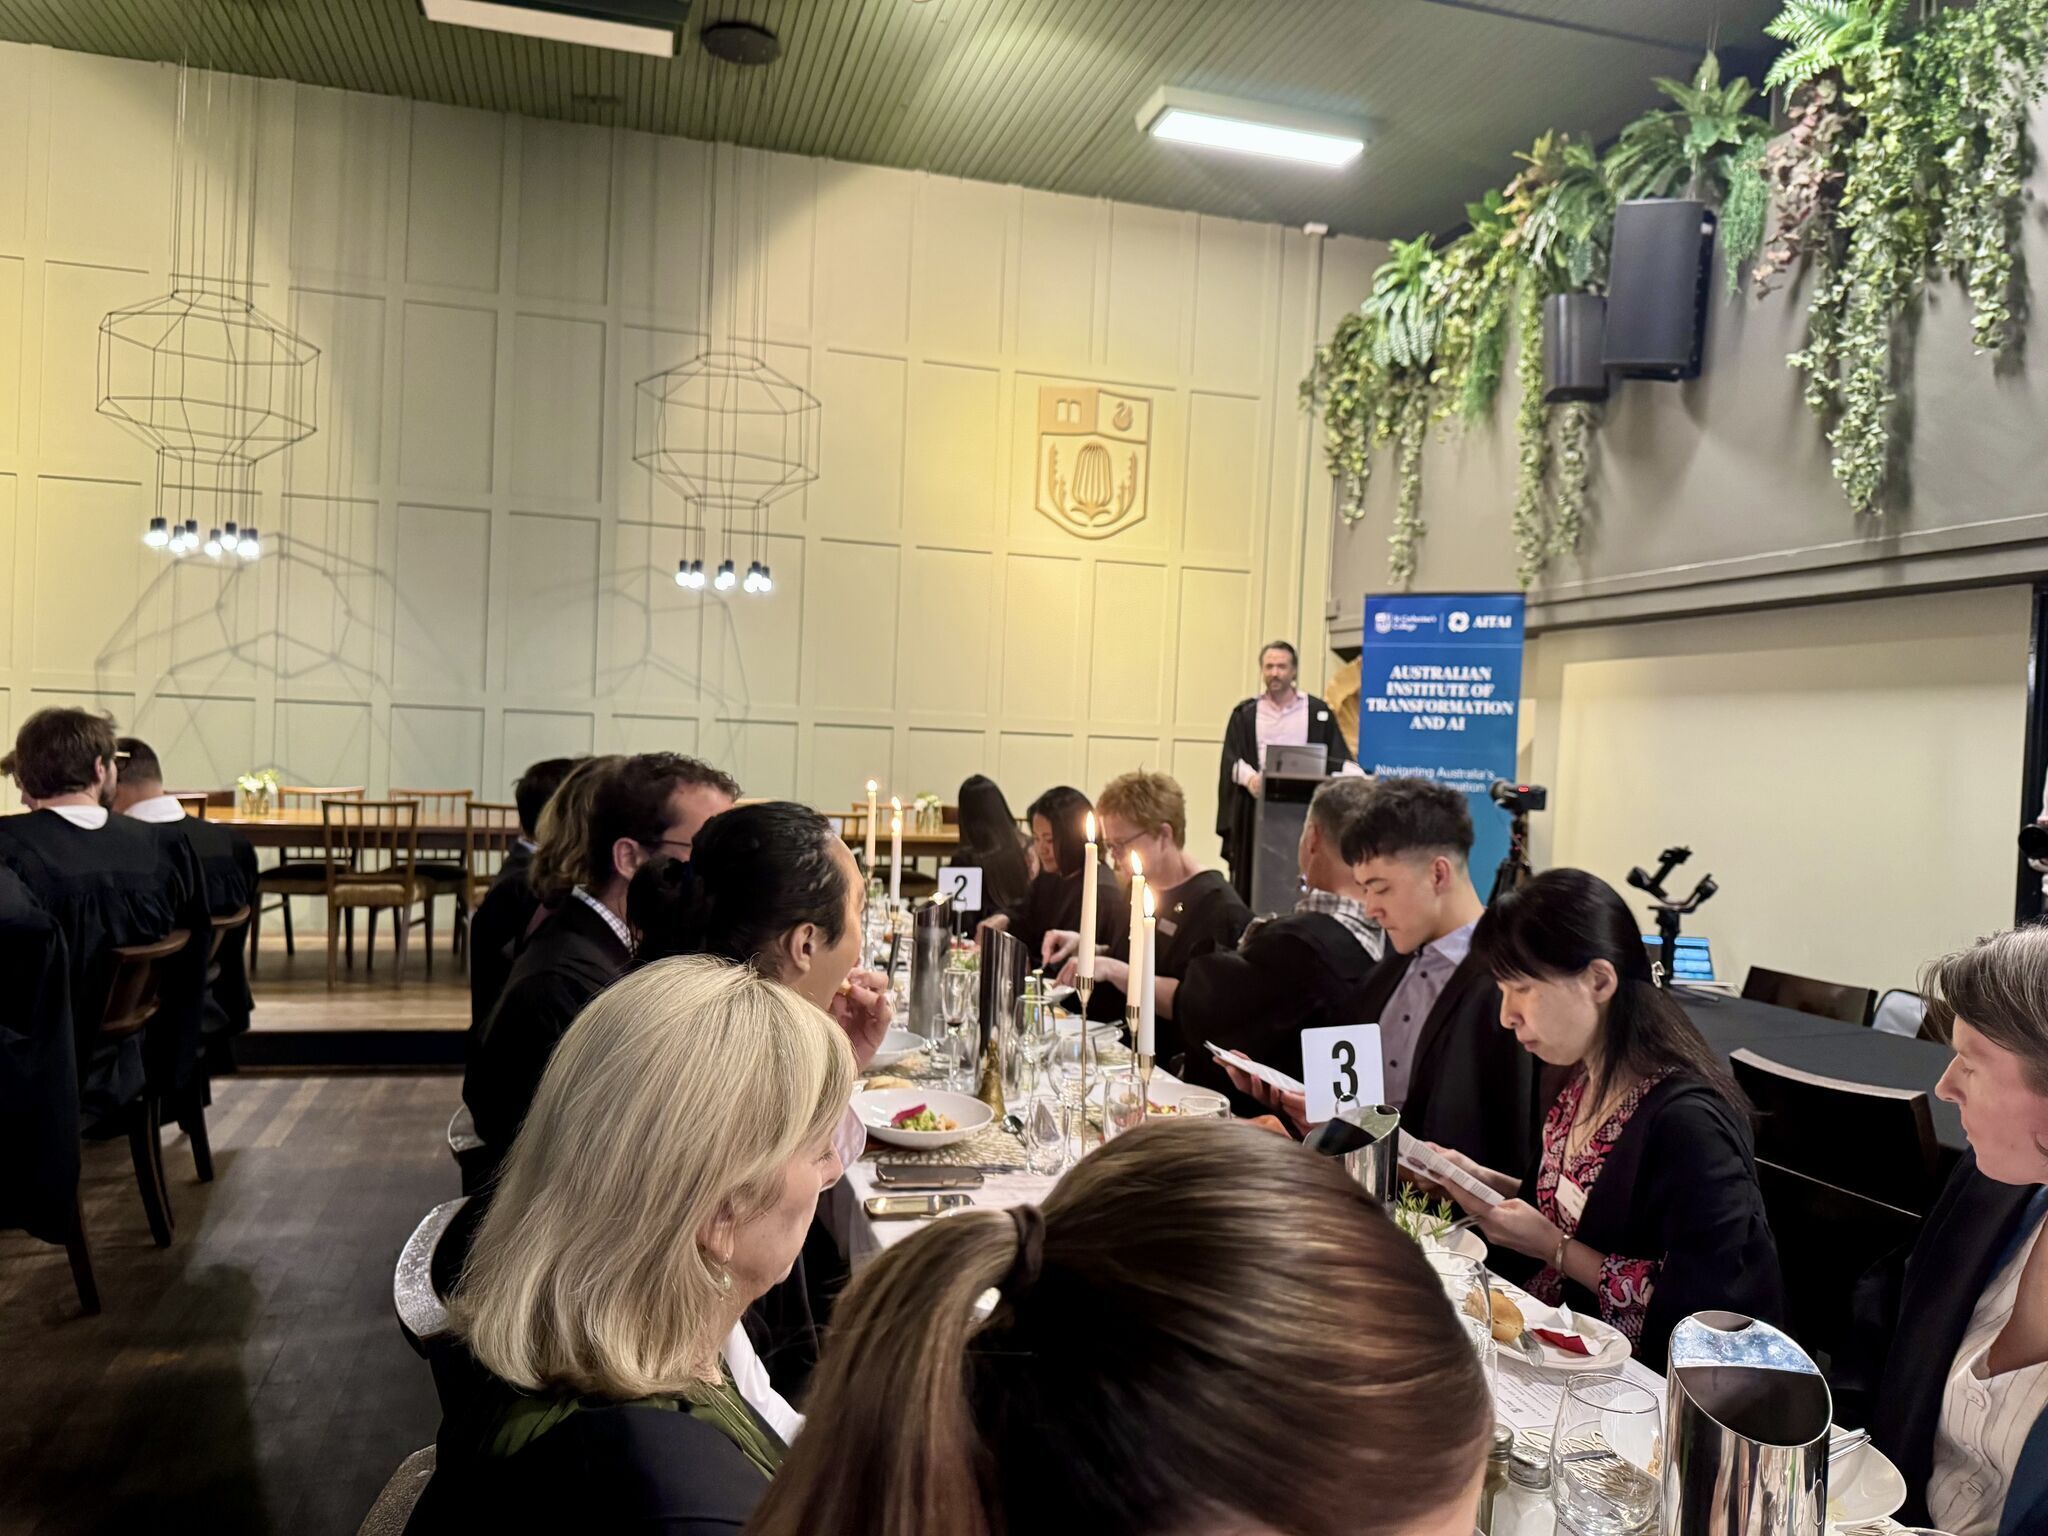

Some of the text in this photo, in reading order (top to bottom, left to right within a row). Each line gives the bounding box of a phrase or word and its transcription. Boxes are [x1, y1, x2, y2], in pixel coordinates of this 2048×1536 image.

[1390, 665, 1493, 681] AUSTRALIAN
[1386, 681, 1495, 698] INSTITUTE OF
[1366, 697, 1515, 716] TRANSFORMATION
[1410, 715, 1466, 731] AND AI
[1436, 766, 1495, 781] Australia's
[954, 874, 968, 902] 2
[1331, 1040, 1359, 1102] 3
